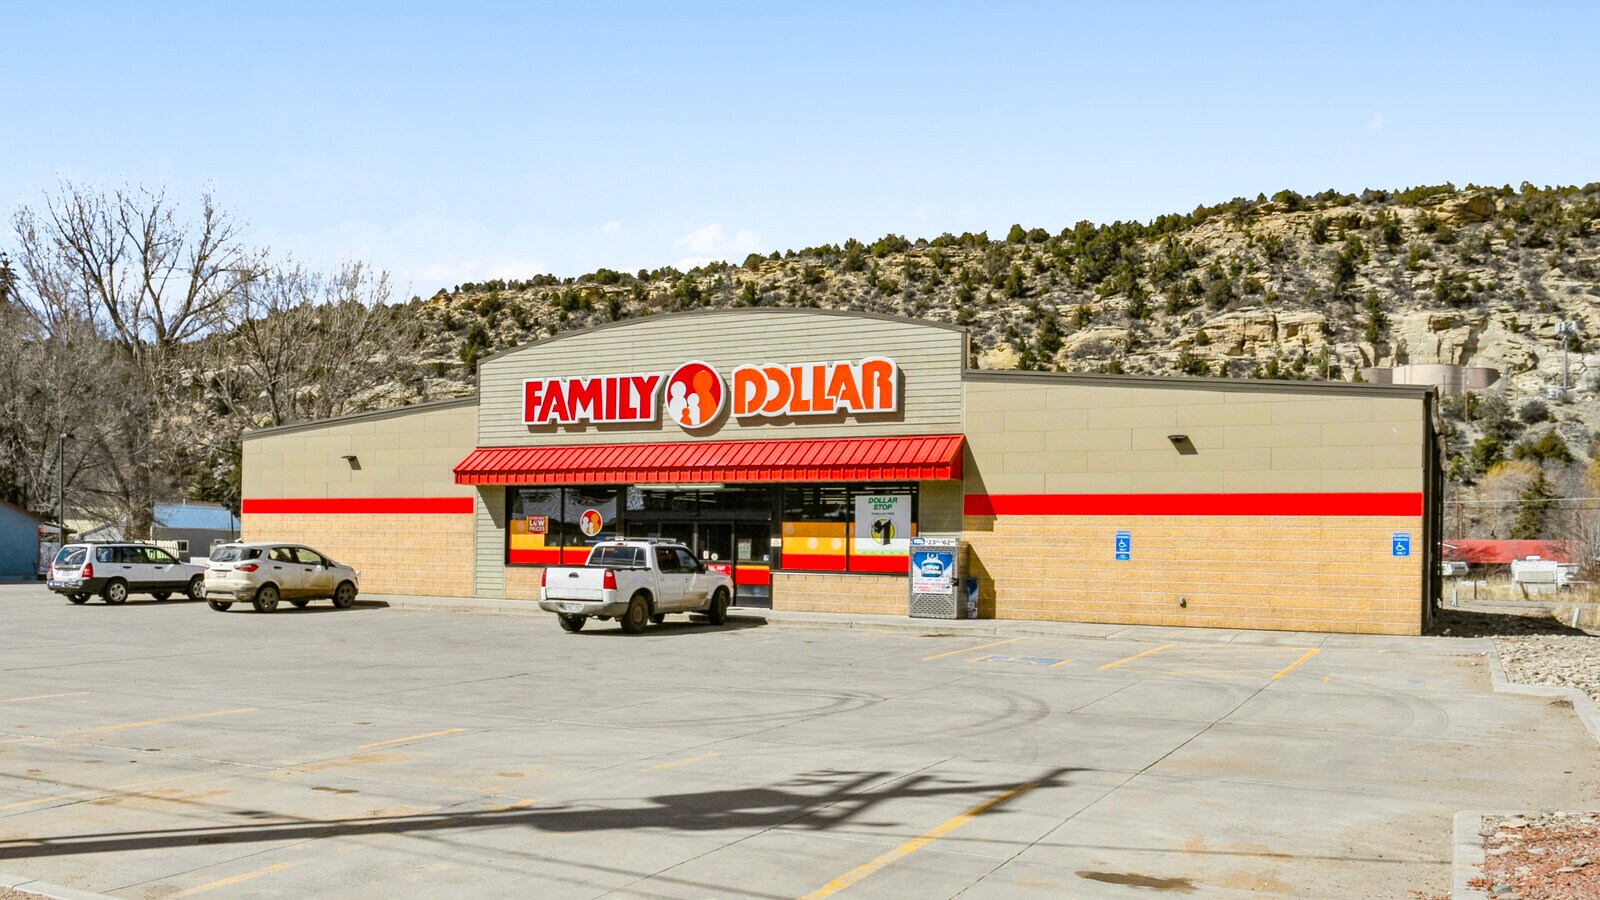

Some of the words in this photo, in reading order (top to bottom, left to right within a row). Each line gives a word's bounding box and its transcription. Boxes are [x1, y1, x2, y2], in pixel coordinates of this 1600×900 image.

[525, 375, 660, 424] FAMILY
[733, 360, 895, 416] DOLLAR
[868, 496, 898, 504] DOLLAR
